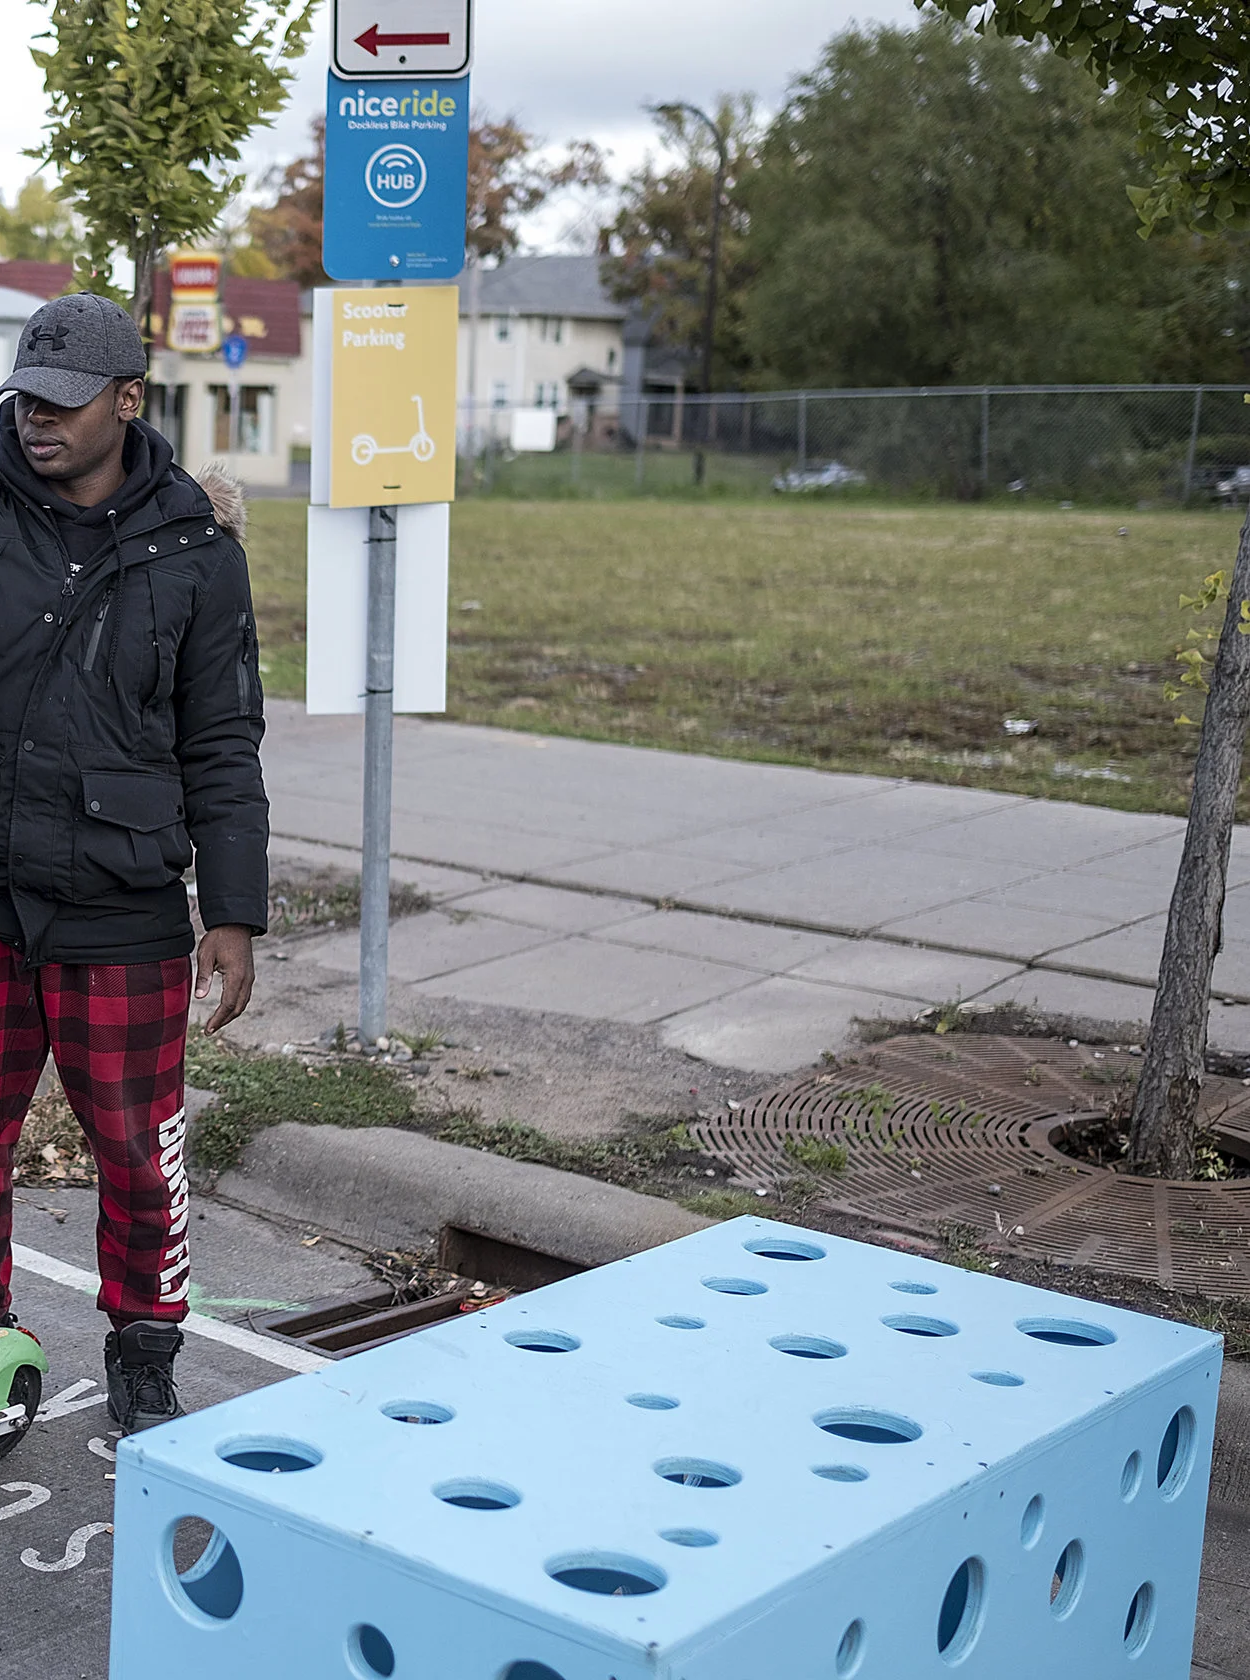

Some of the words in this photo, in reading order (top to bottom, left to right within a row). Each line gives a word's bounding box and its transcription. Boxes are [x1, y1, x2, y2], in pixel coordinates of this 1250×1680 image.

[339, 88, 456, 118] niceride
[347, 120, 389, 130] Dockless
[391, 120, 410, 130] Bike
[412, 120, 447, 132] Parking
[376, 174, 415, 190] HUB
[342, 302, 409, 320] Scooter
[342, 330, 406, 349] Parking
